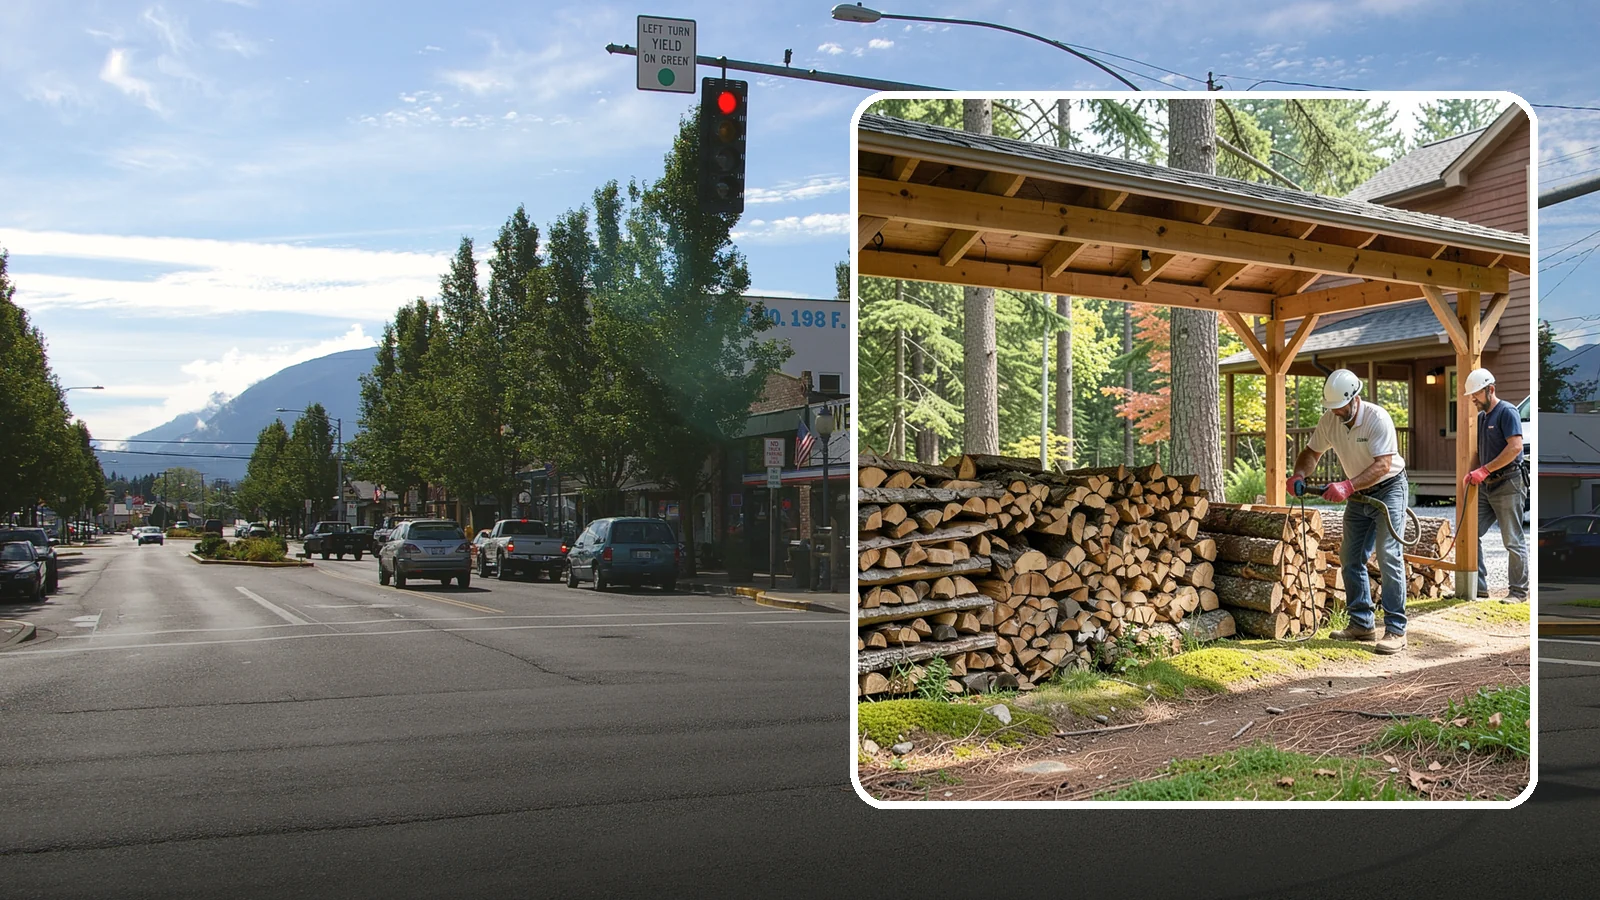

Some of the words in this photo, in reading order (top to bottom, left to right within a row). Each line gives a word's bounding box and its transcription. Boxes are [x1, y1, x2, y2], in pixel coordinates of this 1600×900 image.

[643, 23, 663, 34] LEFT
[668, 25, 690, 37] TURN
[652, 38, 682, 52] YIELD
[644, 53, 656, 64] ON
[661, 54, 689, 66] GREEN
[791, 309, 826, 328] 198
[831, 311, 846, 329] F.
